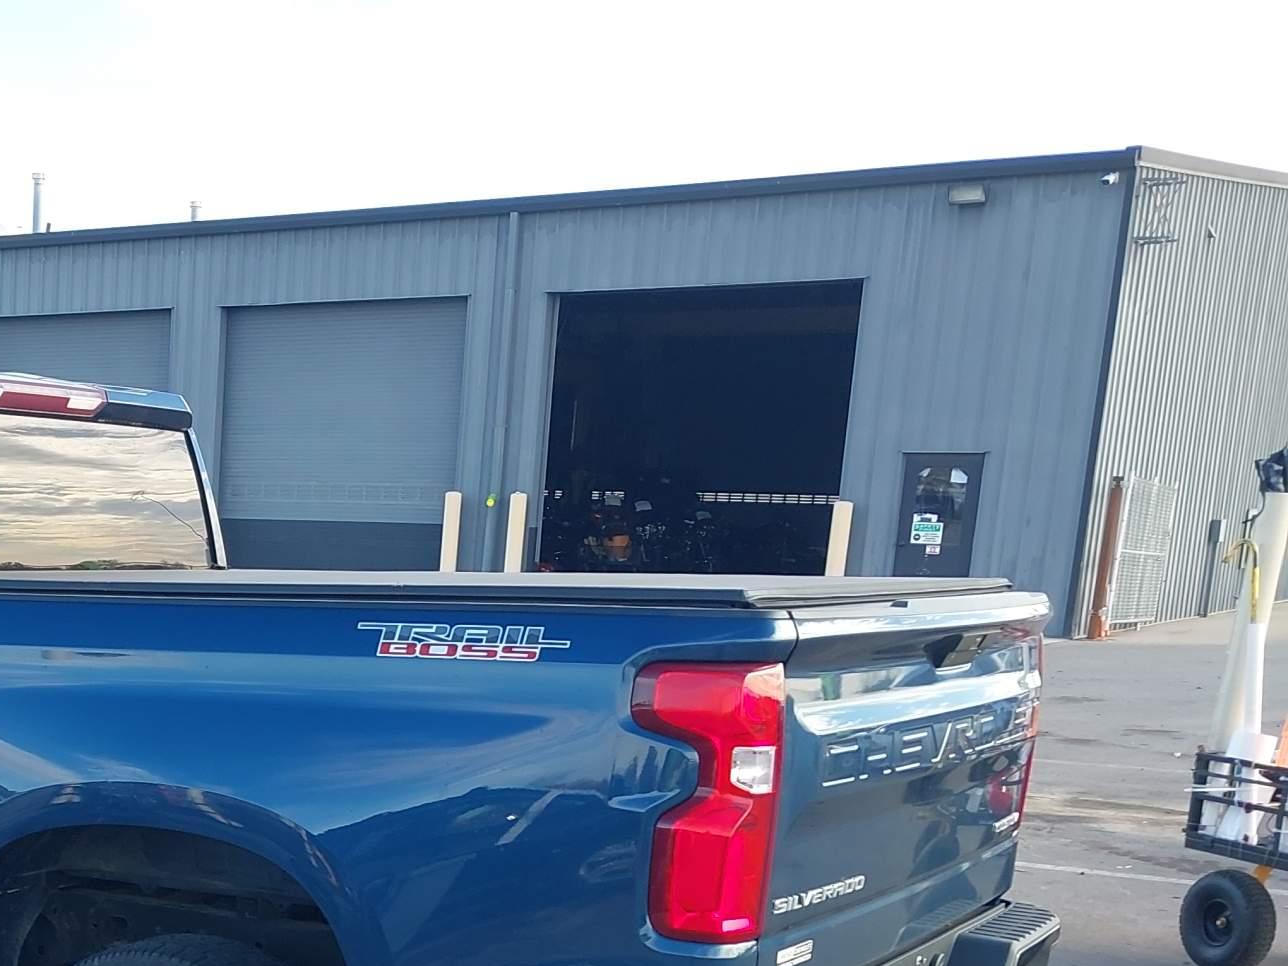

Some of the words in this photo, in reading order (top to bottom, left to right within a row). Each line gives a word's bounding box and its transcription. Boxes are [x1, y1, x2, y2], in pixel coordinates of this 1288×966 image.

[357, 621, 571, 649] TRAIL
[376, 641, 541, 662] BOSS
[773, 874, 865, 915] SILVERADO
